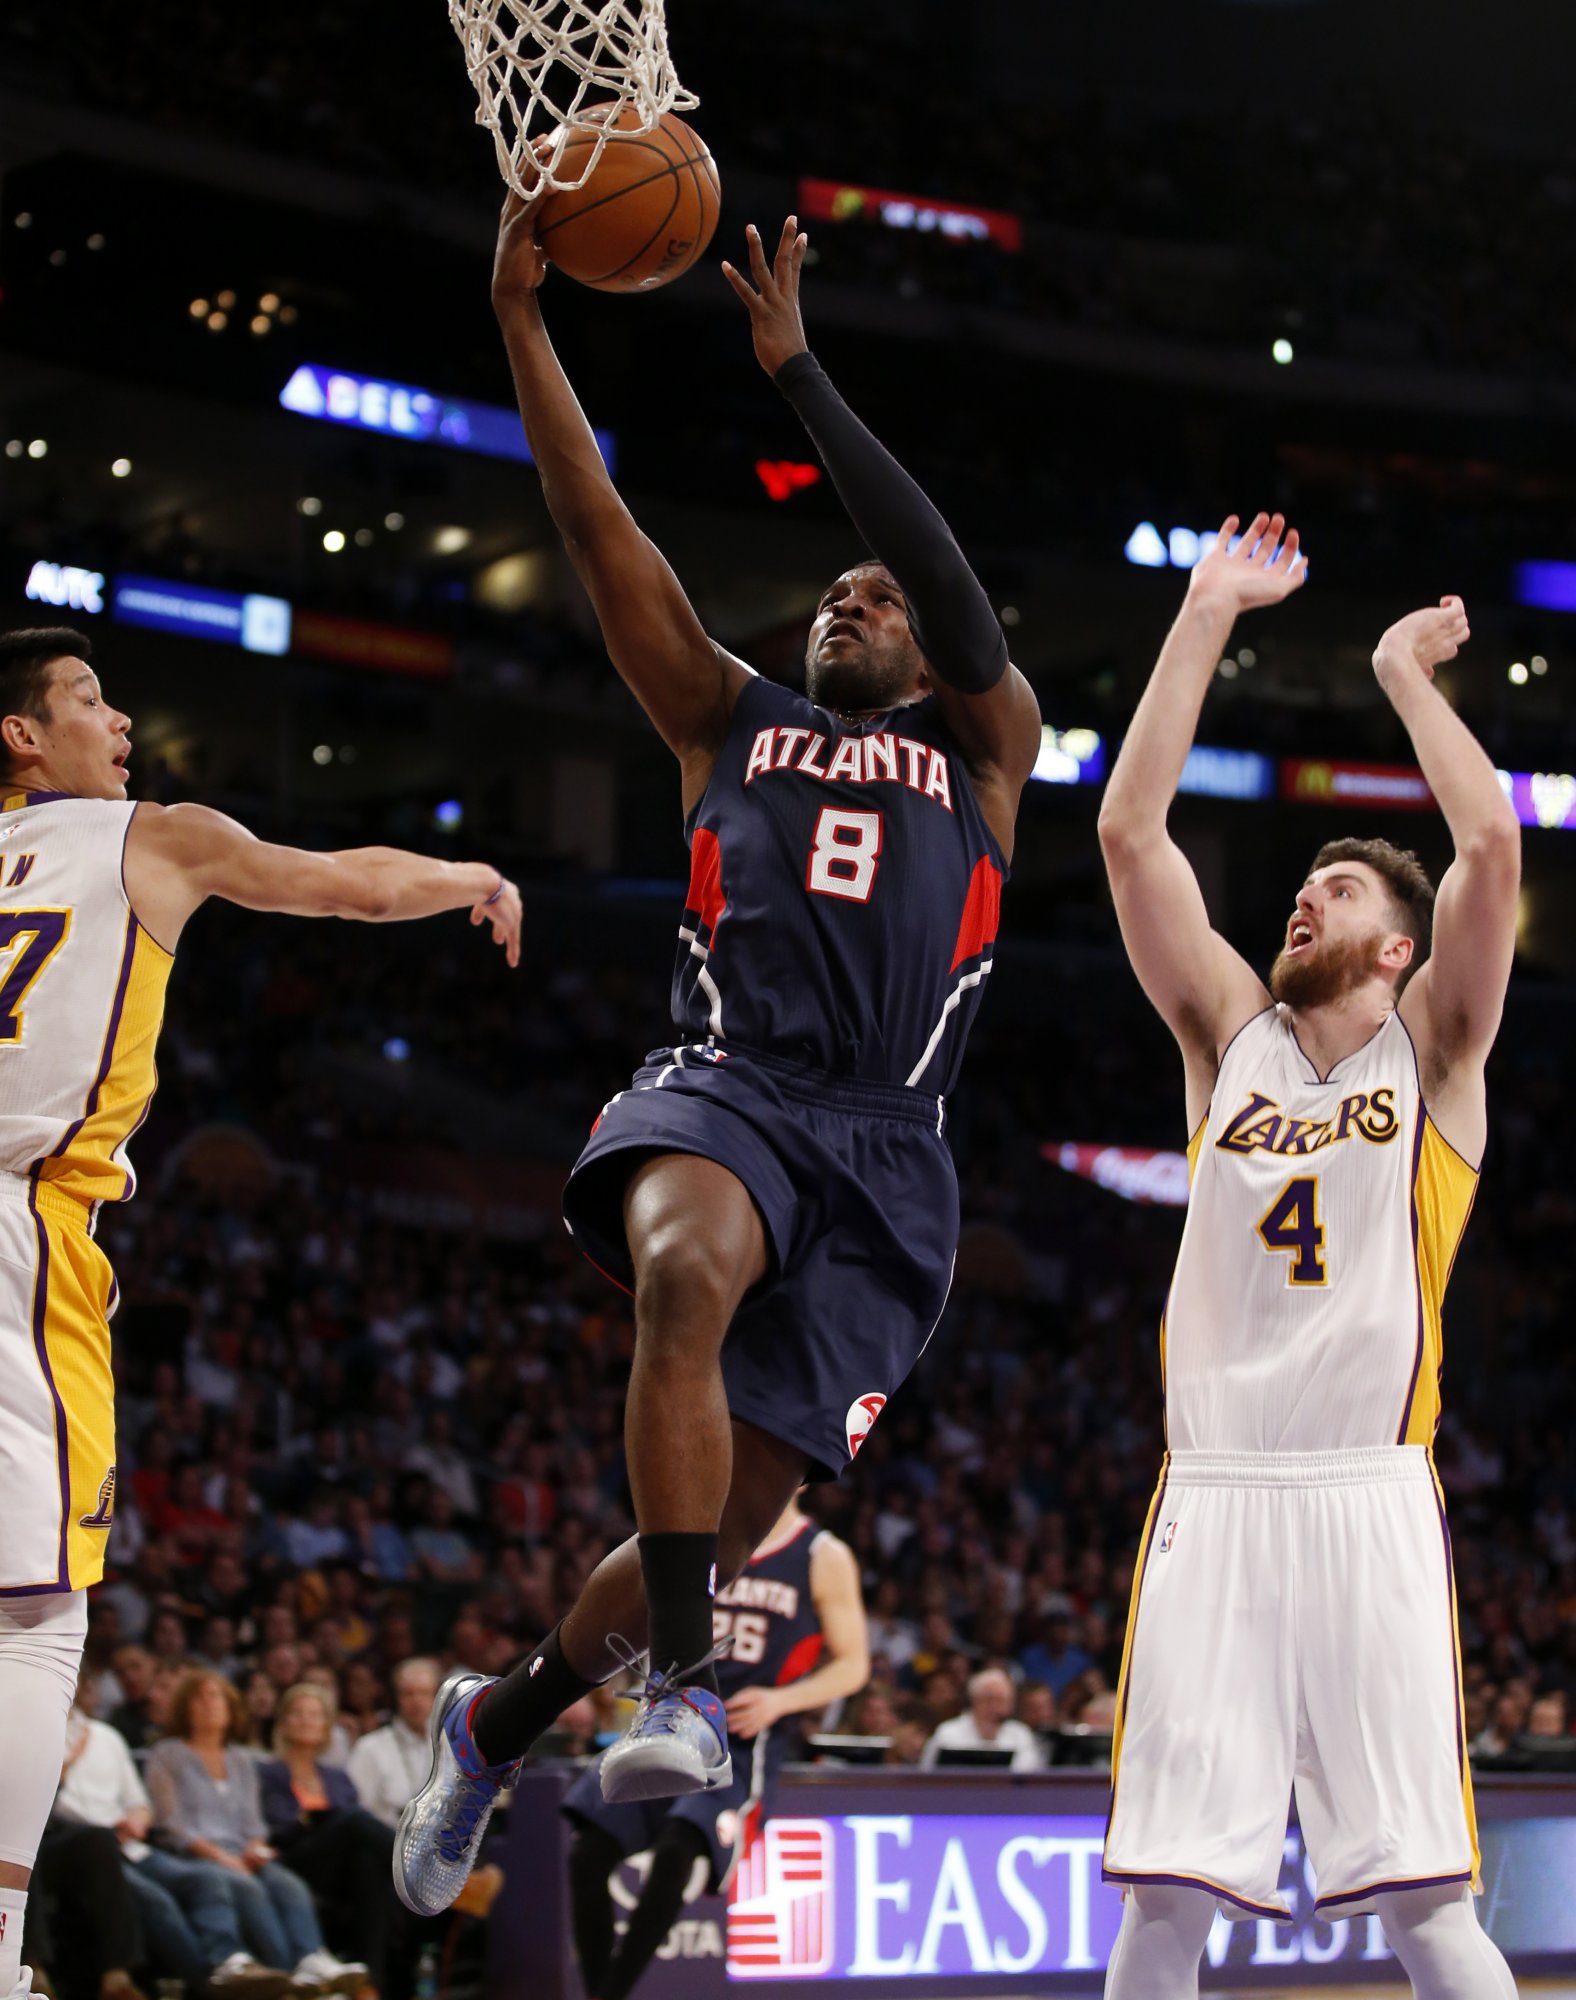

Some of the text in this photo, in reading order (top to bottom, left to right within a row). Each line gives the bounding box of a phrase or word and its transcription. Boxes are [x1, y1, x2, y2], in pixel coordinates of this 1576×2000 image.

[744, 726, 953, 814] ATLANTA
[805, 804, 884, 904] 8
[1255, 1174, 1328, 1286] 4
[844, 1814, 1105, 1976] EAST
